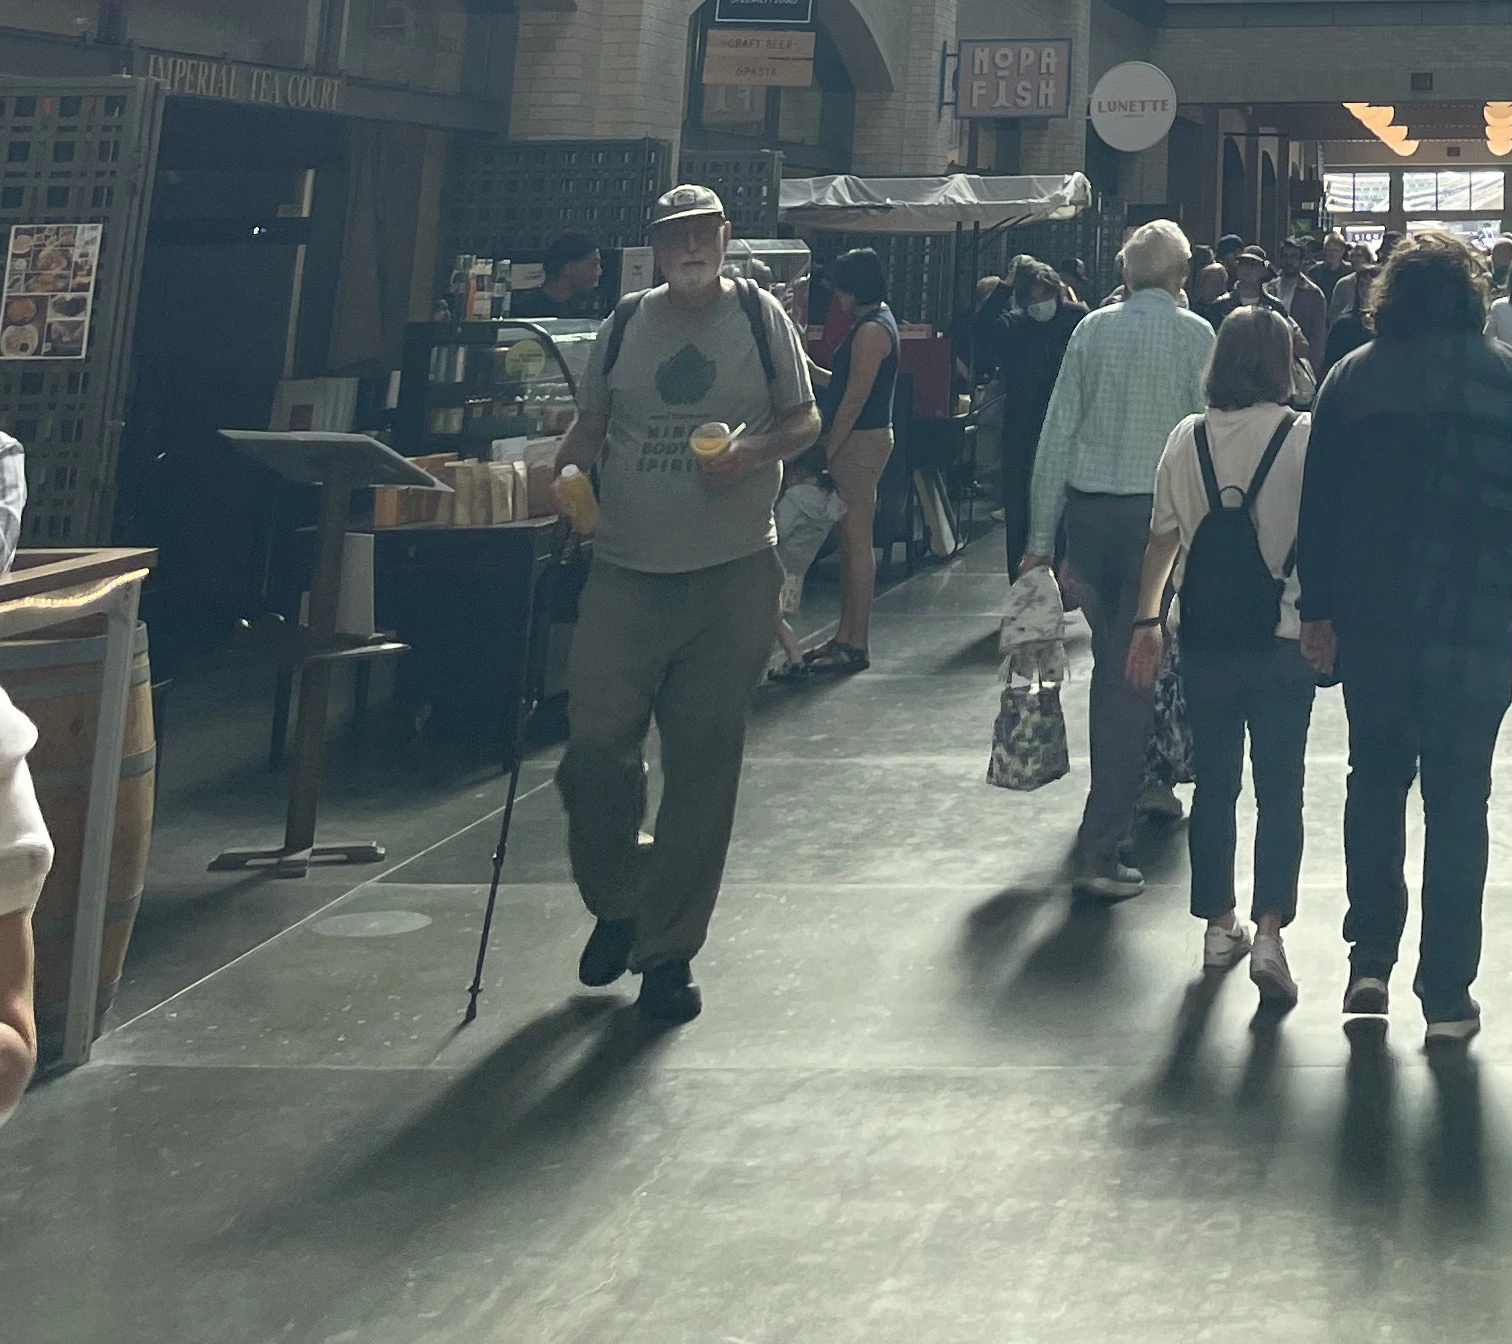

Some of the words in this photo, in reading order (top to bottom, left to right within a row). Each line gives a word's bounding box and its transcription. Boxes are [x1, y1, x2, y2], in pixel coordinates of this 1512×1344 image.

[973, 47, 1057, 78] NOPA
[150, 54, 239, 99] IMPERIAL
[251, 68, 281, 104] TEA
[287, 75, 342, 111] COURT
[971, 79, 1056, 109] FISH
[1097, 98, 1169, 114] LUNETTE
